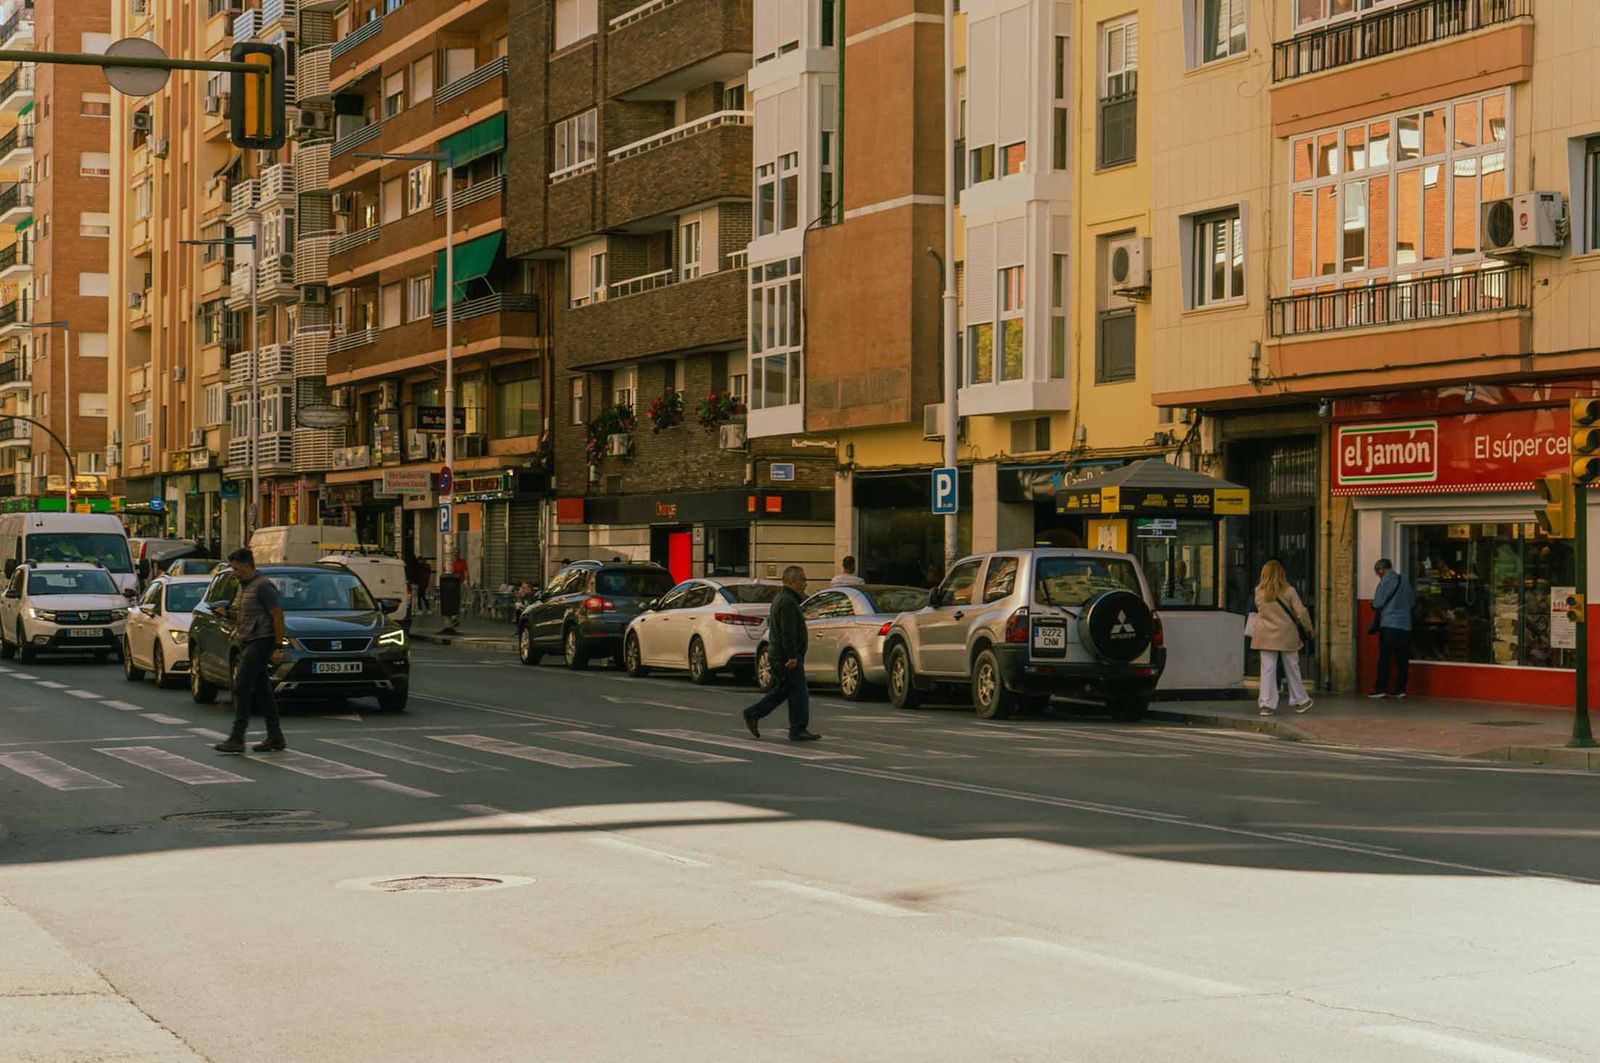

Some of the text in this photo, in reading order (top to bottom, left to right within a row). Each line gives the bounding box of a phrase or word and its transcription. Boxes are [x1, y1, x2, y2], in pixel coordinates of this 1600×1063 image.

[1344, 429, 1431, 473] el jamón
[1474, 436, 1490, 460] El
[1493, 433, 1542, 463] súper
[937, 473, 952, 509] P
[1192, 494, 1210, 505] 120
[441, 509, 448, 530] P
[1041, 627, 1062, 638] 6272
[319, 663, 341, 673] 0363
